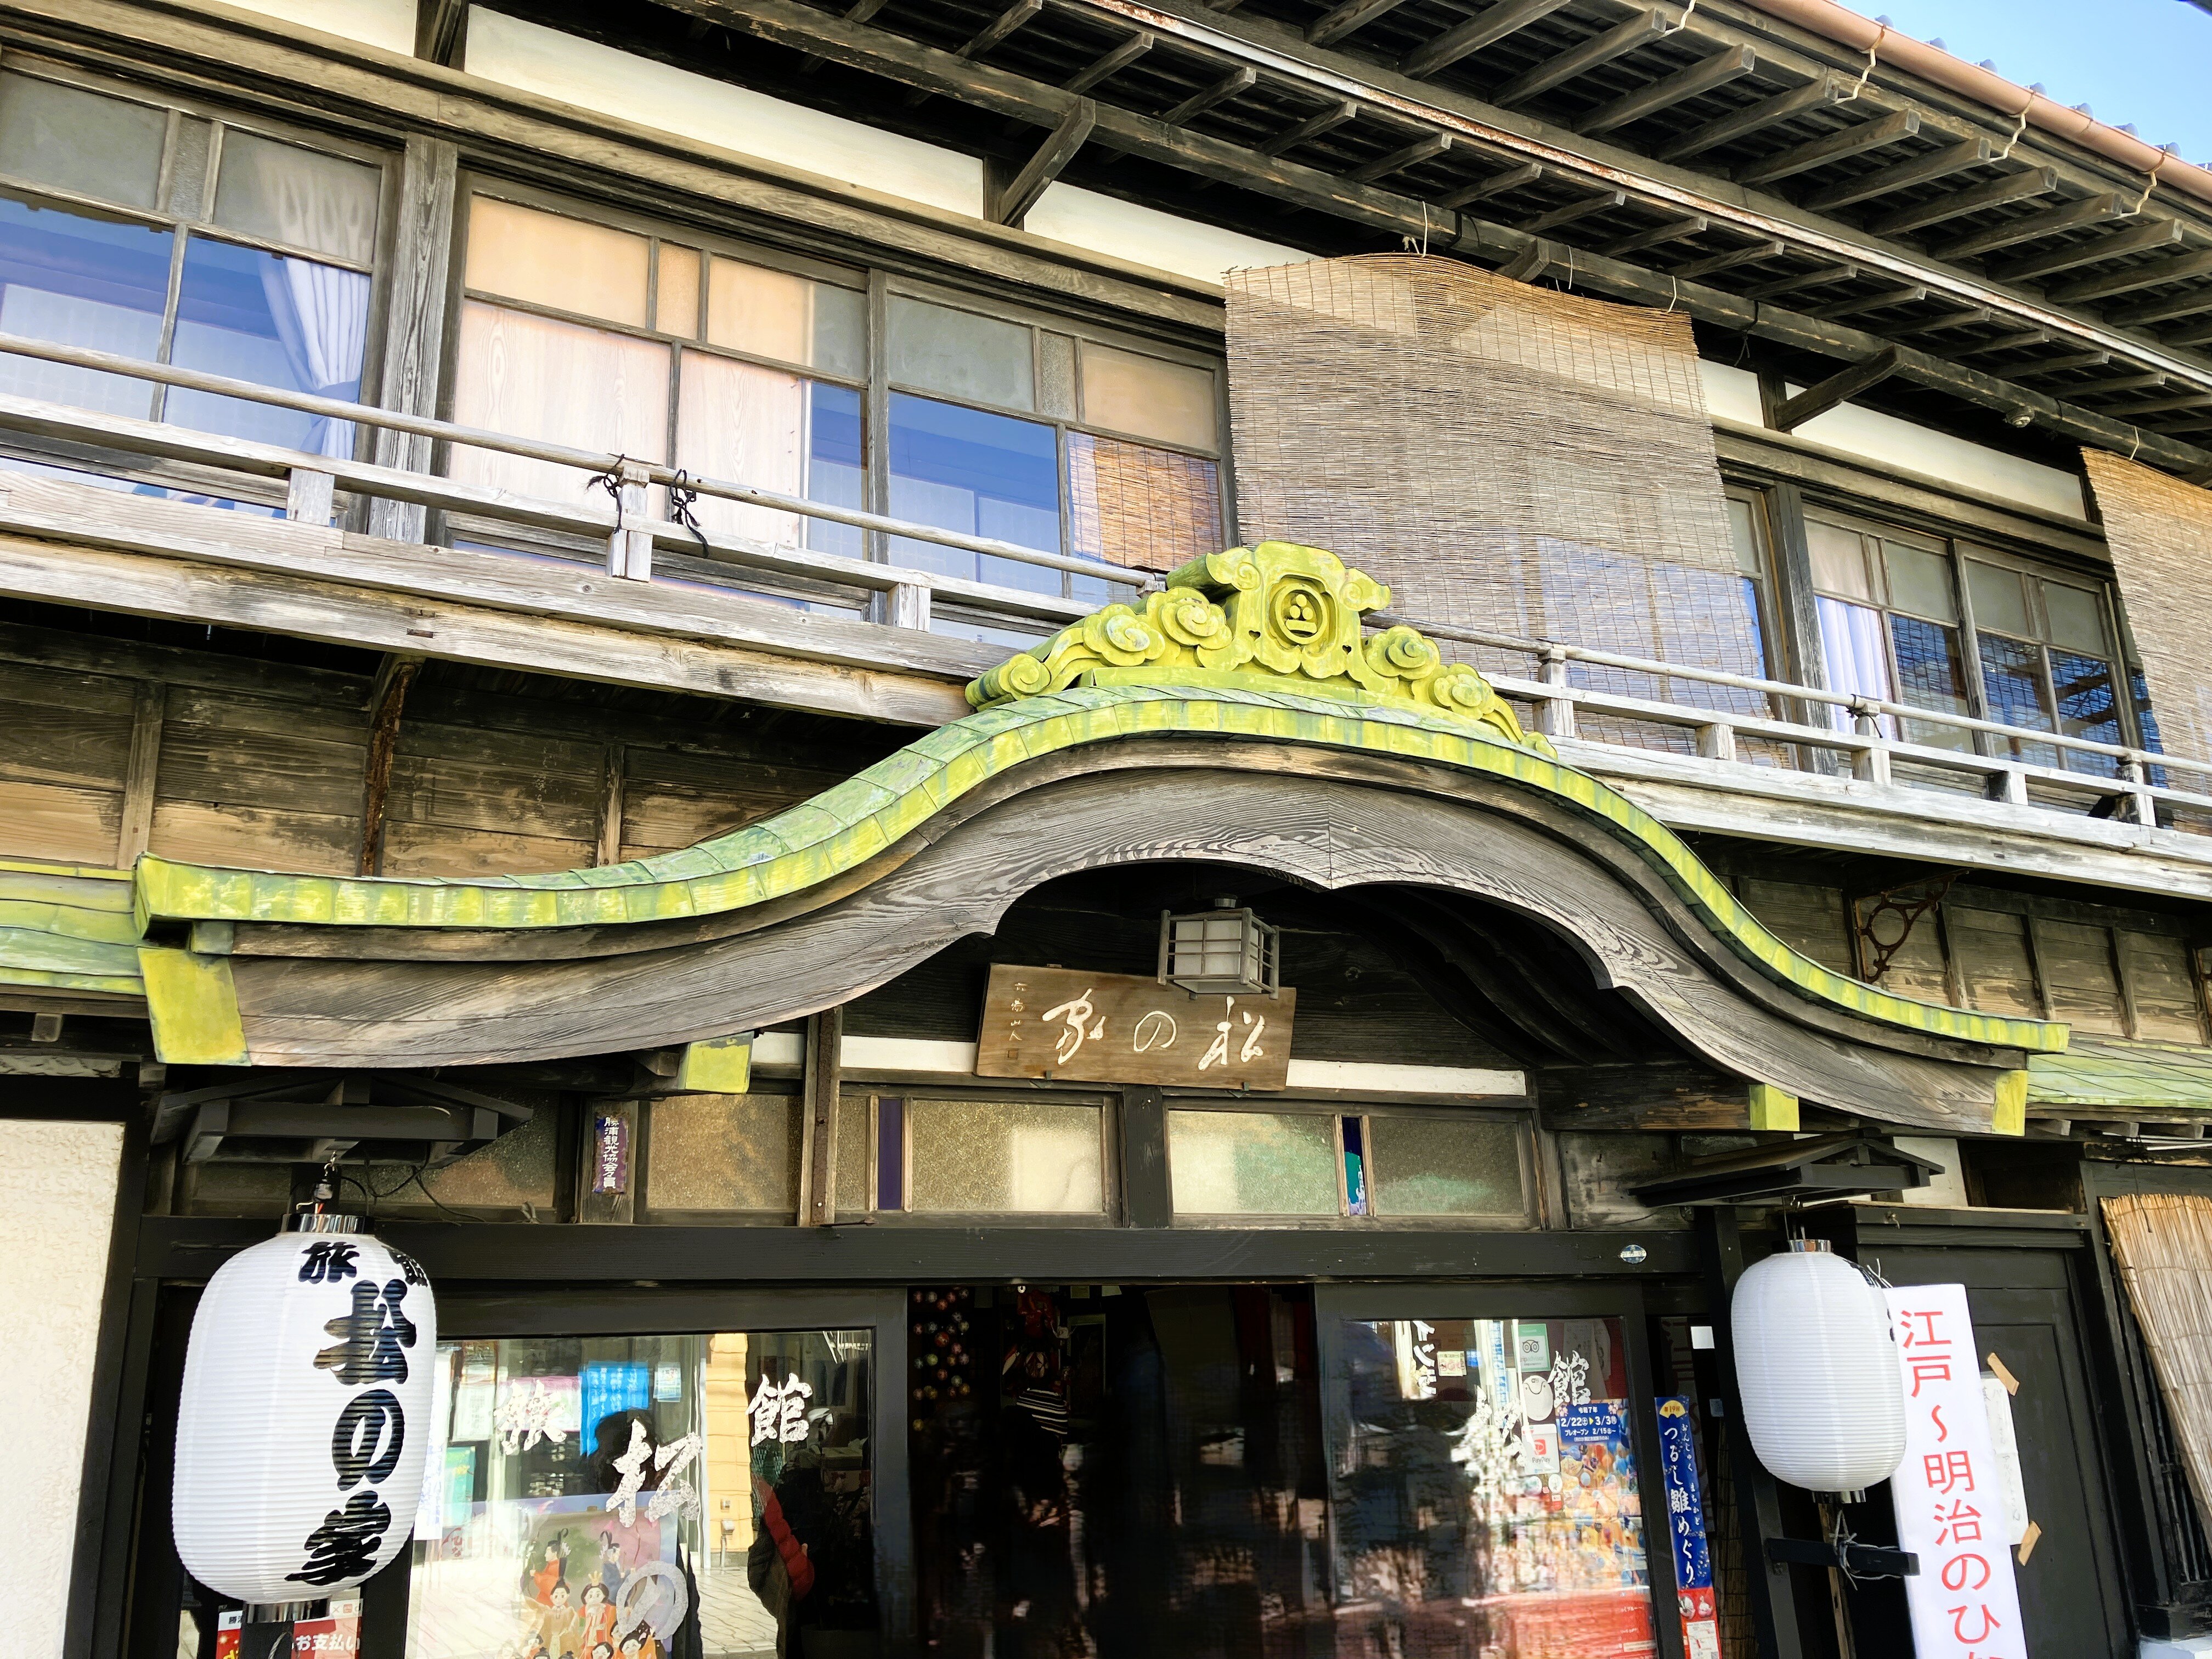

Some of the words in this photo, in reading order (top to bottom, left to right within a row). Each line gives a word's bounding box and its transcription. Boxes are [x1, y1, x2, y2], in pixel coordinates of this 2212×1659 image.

[284, 1279, 417, 1586] 松の家
[1664, 1427, 1694, 1584] つるし雛めぐり
[1899, 1308, 2005, 1659] 江戸〜明治のひ
[292, 1633, 360, 1651] お支払い
